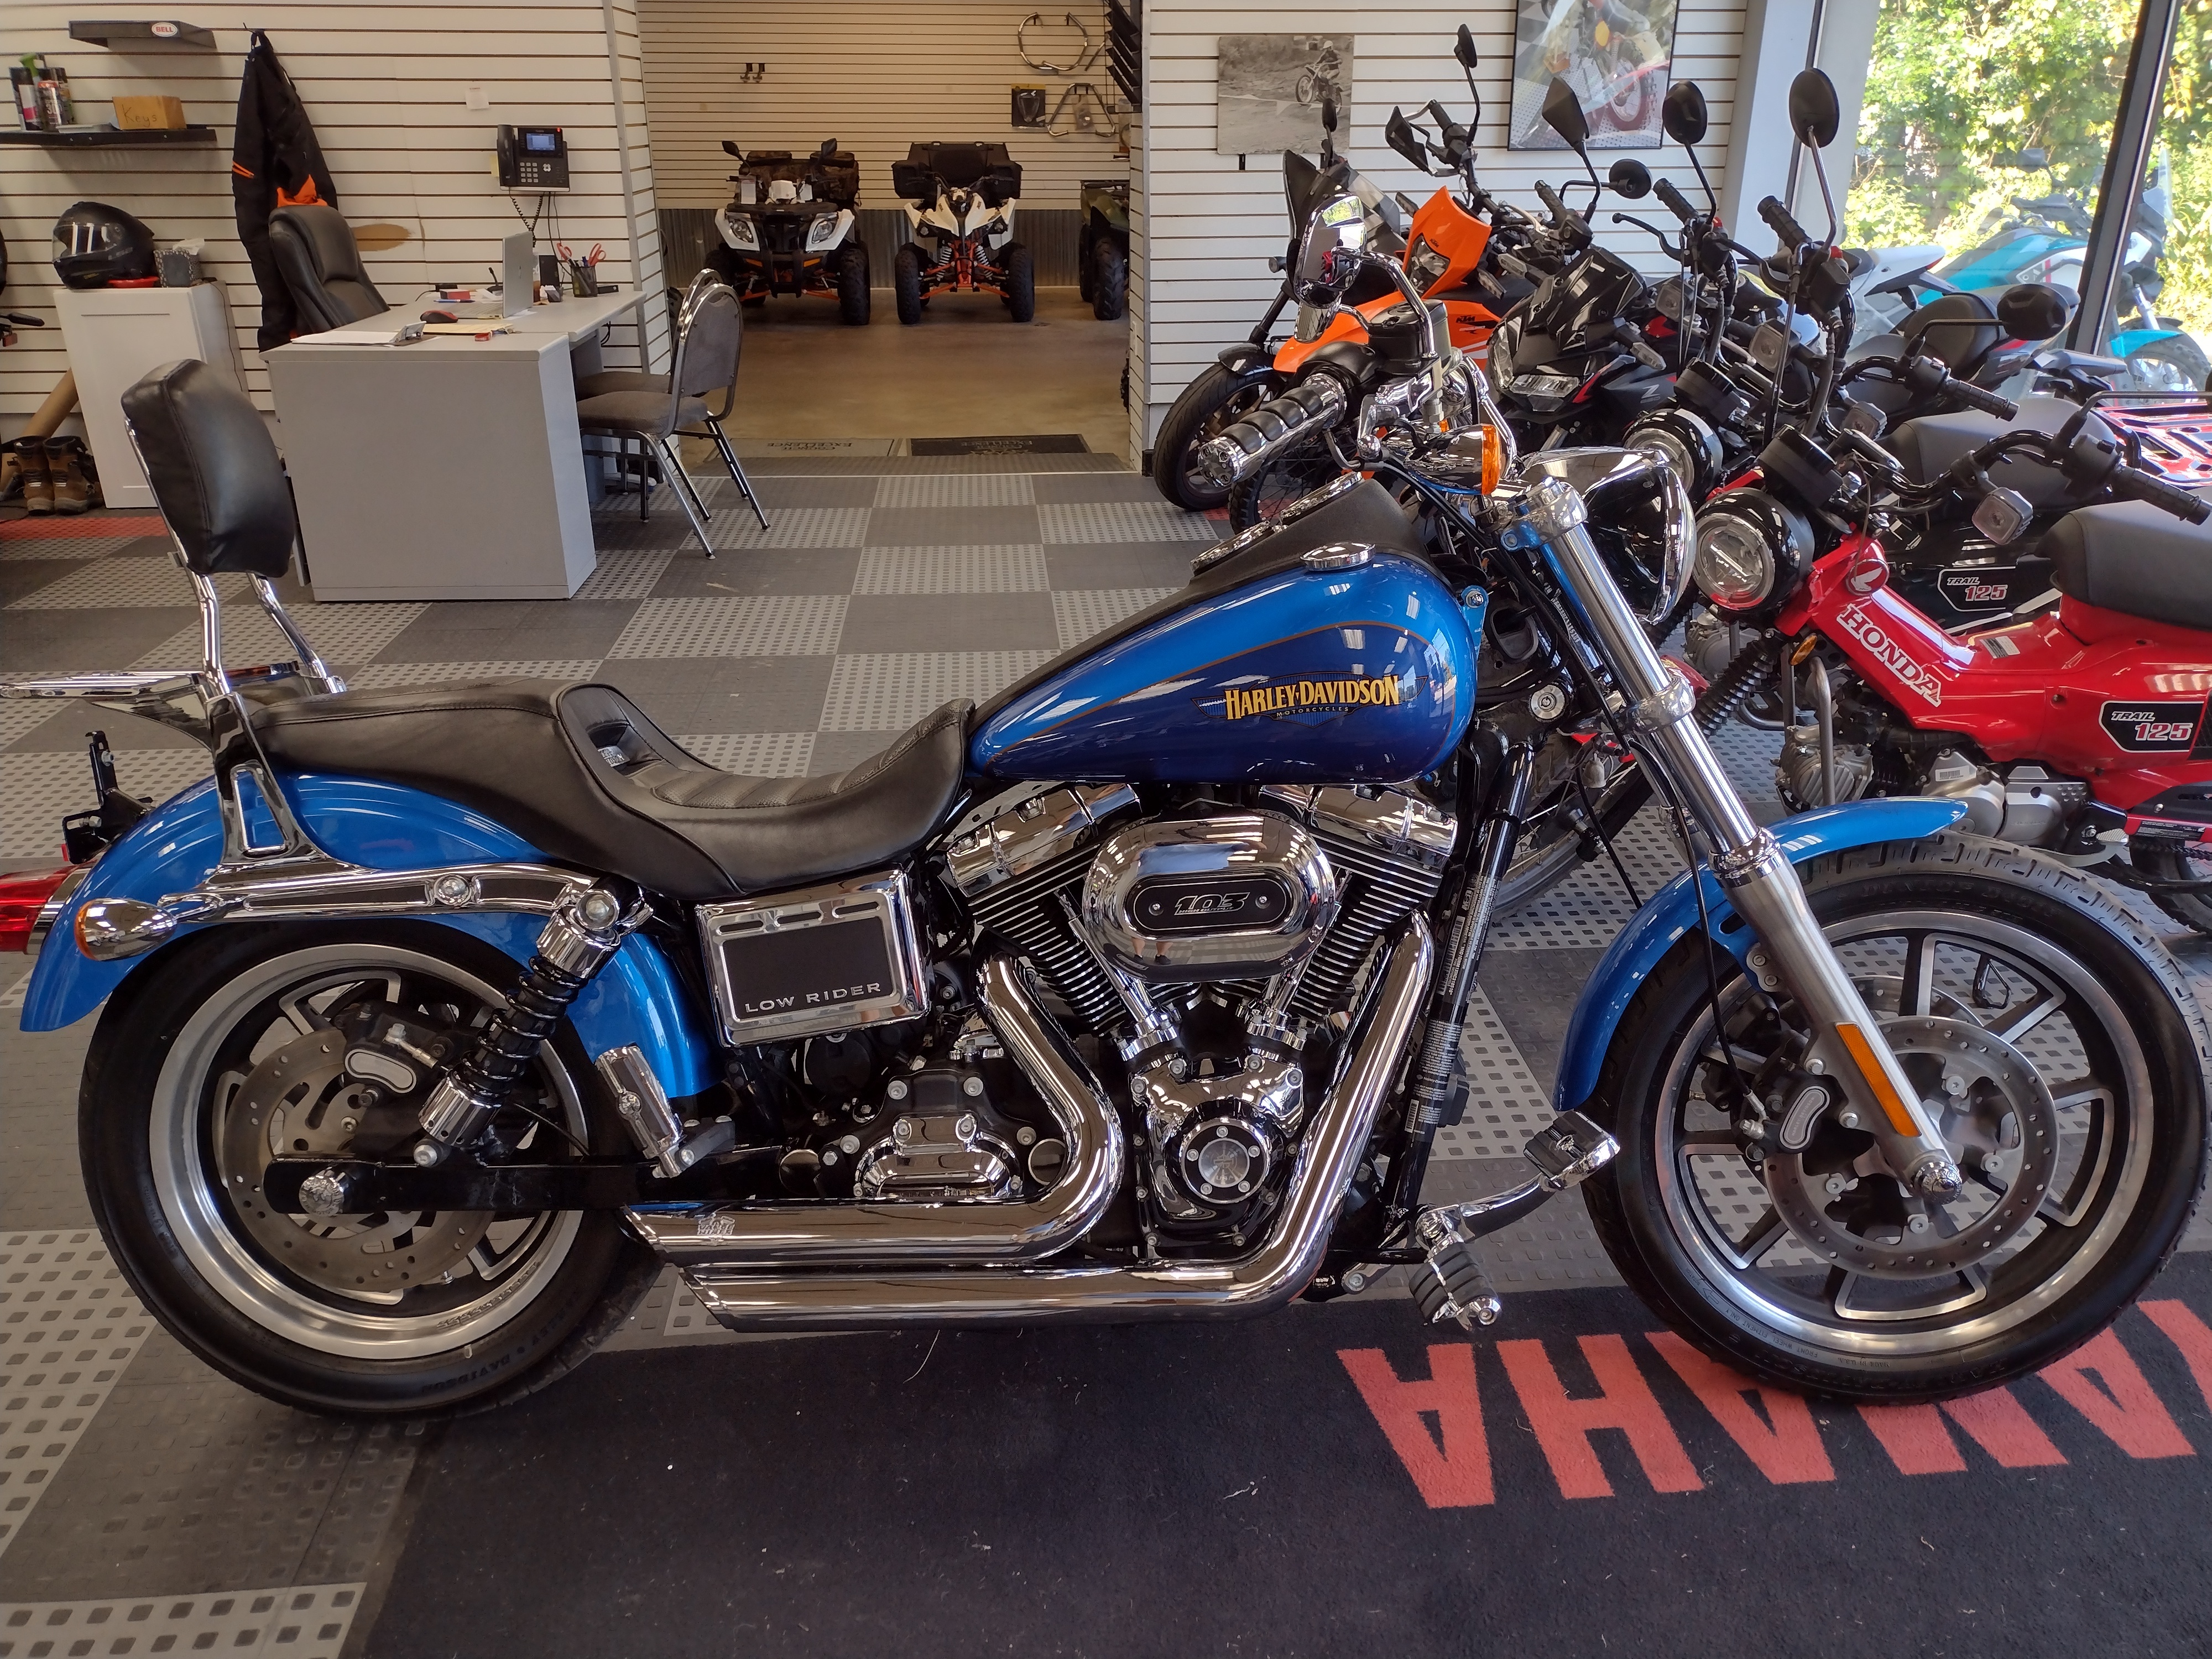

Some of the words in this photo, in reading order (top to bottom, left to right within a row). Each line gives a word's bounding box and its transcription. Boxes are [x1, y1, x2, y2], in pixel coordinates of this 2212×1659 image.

[122, 104, 158, 127] Keys
[1455, 315, 1476, 324] KTM
[1947, 577, 1980, 586] TRAIL
[1965, 585, 2008, 601] 125
[1836, 603, 1941, 707] HONDA
[1224, 675, 1400, 720] HARLEY-DAVIDSON
[1276, 707, 1349, 717] MOTORCYCLES
[2111, 711, 2156, 722] TRAIL
[2135, 723, 2193, 741] 125
[1174, 892, 1250, 915] 103
[744, 996, 795, 1013] LOW
[806, 982, 881, 1003] RIDER
[1725, 1308, 1740, 1321] ONLY
[1741, 1320, 1768, 1338] FITMENT
[1771, 1337, 1792, 1350] WHEEL
[1796, 1346, 1818, 1358] FRONT
